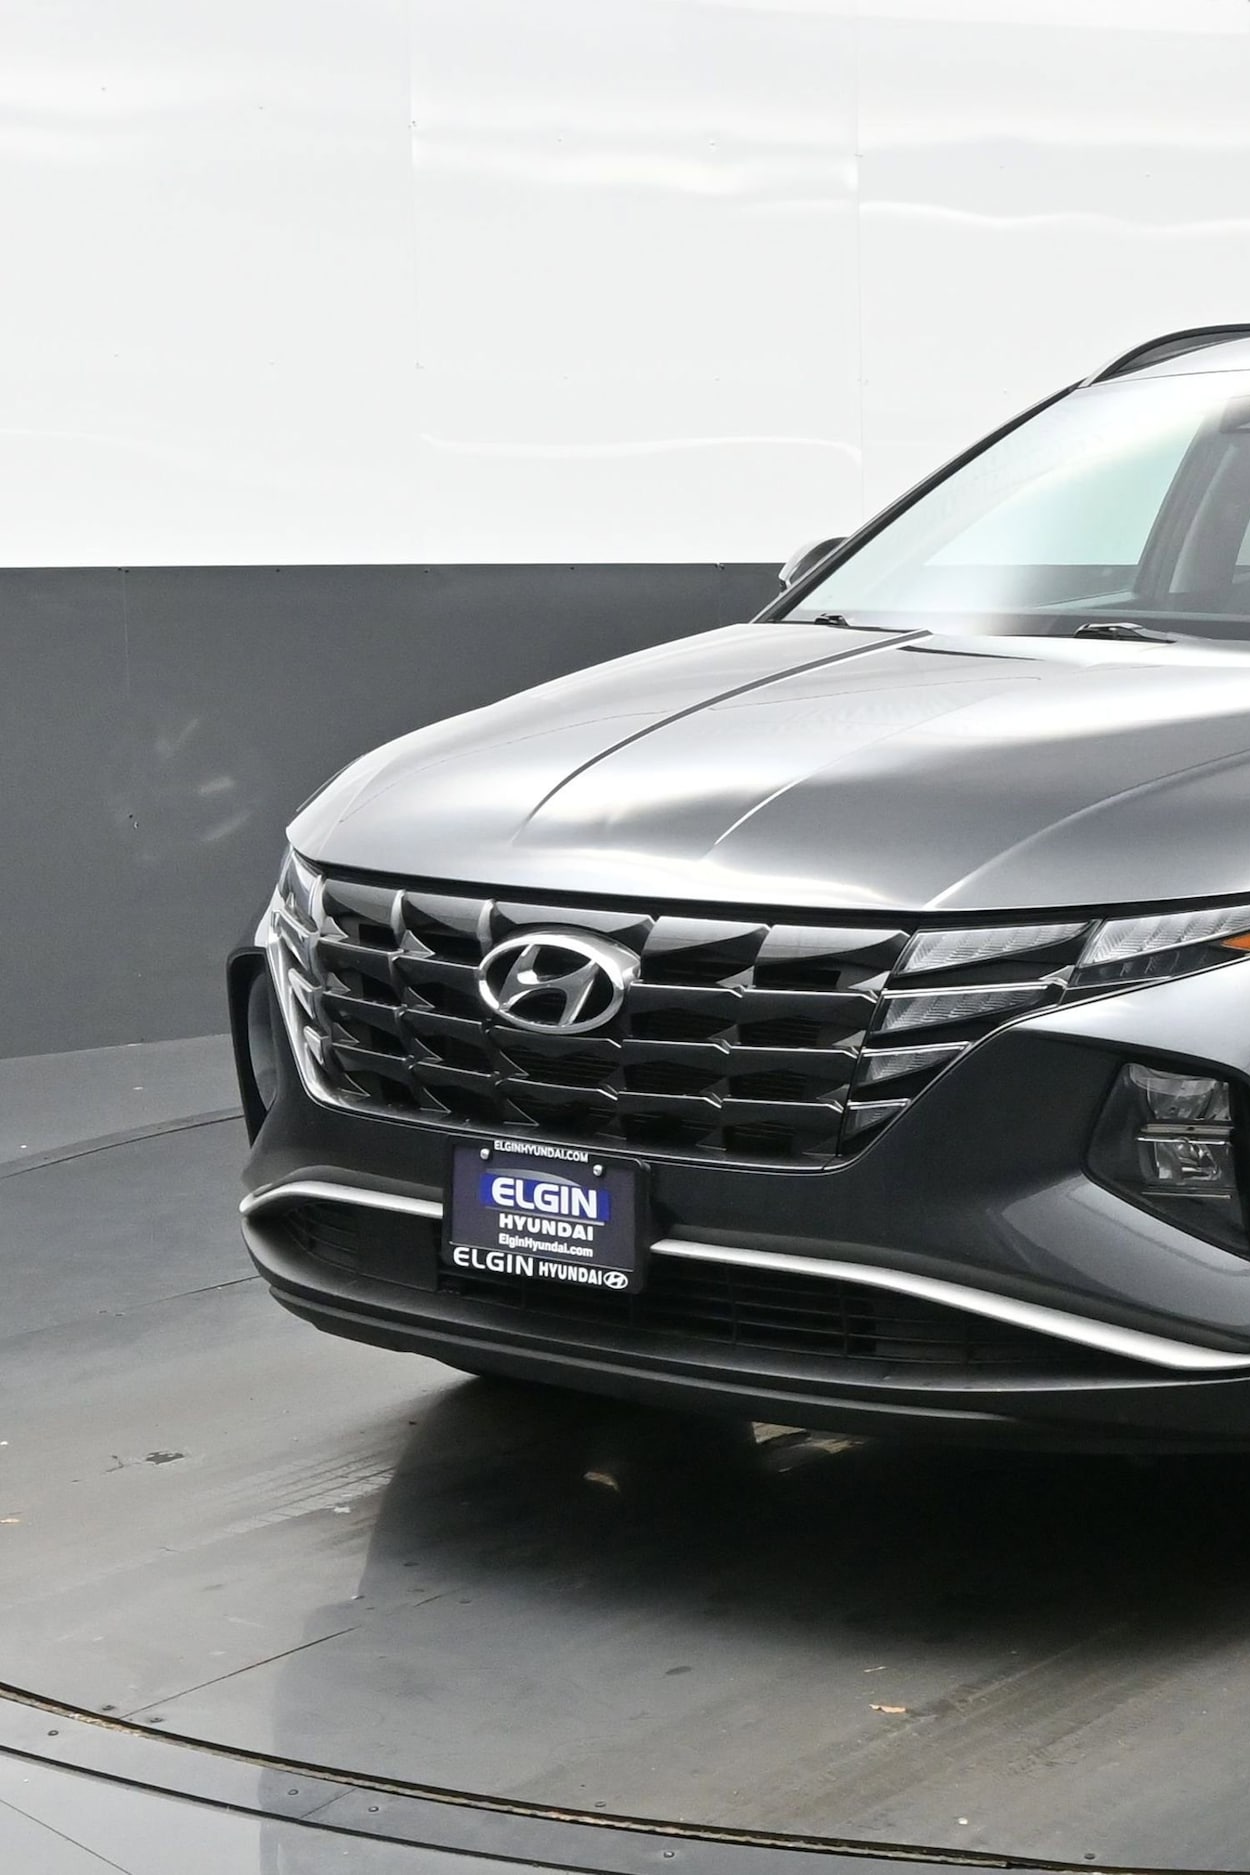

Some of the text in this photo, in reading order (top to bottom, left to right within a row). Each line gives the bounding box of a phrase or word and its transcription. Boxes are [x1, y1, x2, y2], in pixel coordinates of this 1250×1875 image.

[493, 1140, 589, 1163] ELGINHYUNDAI.COM
[491, 1176, 598, 1219] ELGIN
[499, 1213, 594, 1241] HYUNDAI
[498, 1232, 594, 1258] ElginHyundai.com
[453, 1246, 603, 1286] ELGIN HYUNDAI
